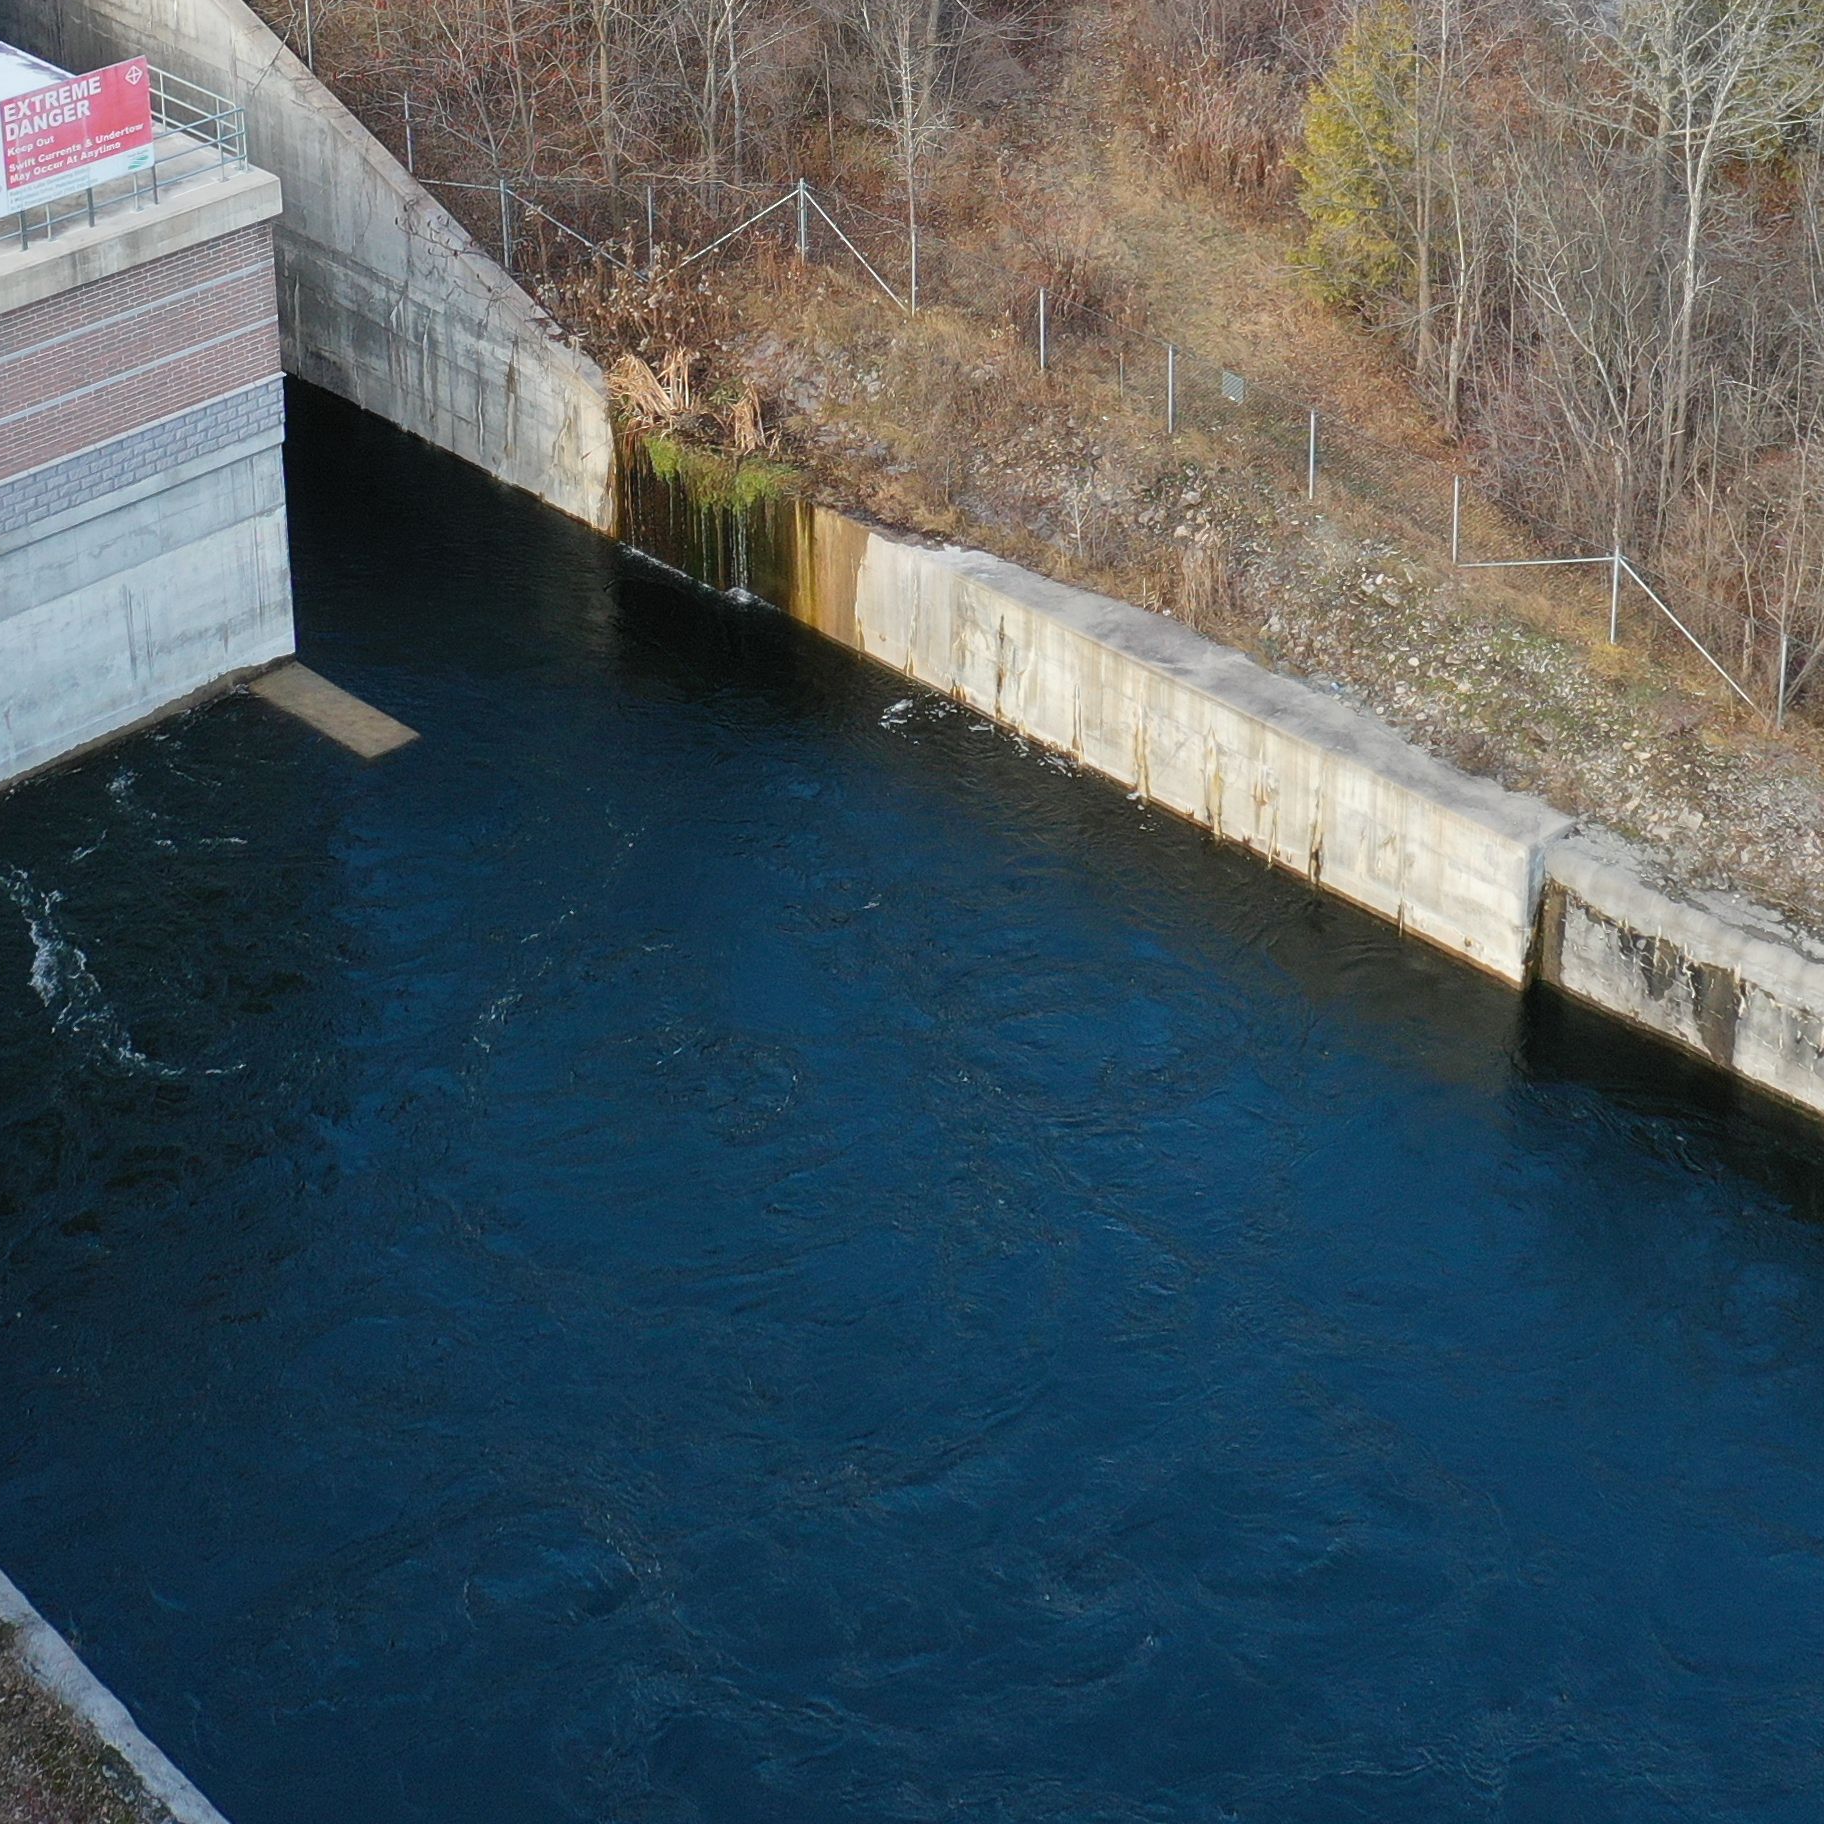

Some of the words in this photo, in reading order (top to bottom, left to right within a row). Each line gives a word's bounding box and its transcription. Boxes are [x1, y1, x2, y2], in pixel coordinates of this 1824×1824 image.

[3, 76, 102, 123] EXTREME
[6, 100, 91, 142] DANGER
[7, 141, 34, 157] Keep
[36, 135, 55, 148] Out
[9, 157, 36, 173] Swift
[38, 143, 82, 163] Currents
[84, 138, 93, 148] &
[95, 123, 144, 144] Undertow
[9, 170, 31, 184] May
[33, 160, 64, 175] Occur
[66, 155, 78, 166] At
[80, 141, 121, 161] Anytime
